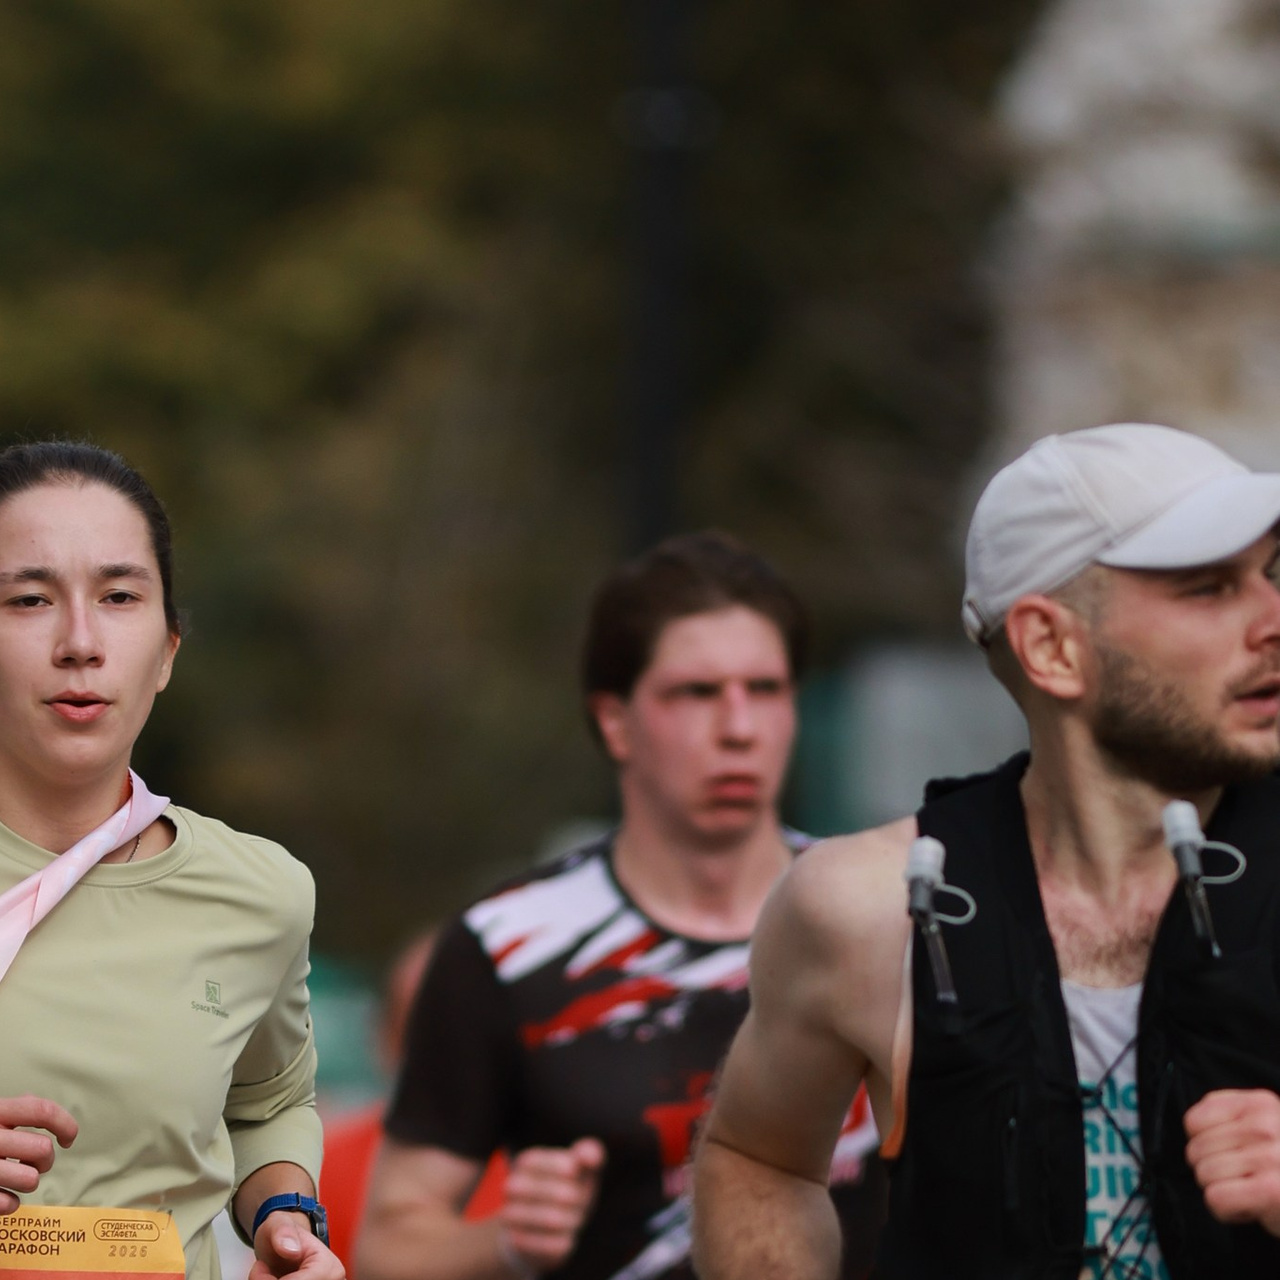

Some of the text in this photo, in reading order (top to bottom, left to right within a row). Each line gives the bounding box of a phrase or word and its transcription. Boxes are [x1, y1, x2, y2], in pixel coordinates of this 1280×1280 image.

[100, 1222, 154, 1232] СТУДЕНЧЕСКАЯ
[100, 1230, 138, 1239] ЭСТАФЕТА
[108, 1245, 149, 1258] 2026
